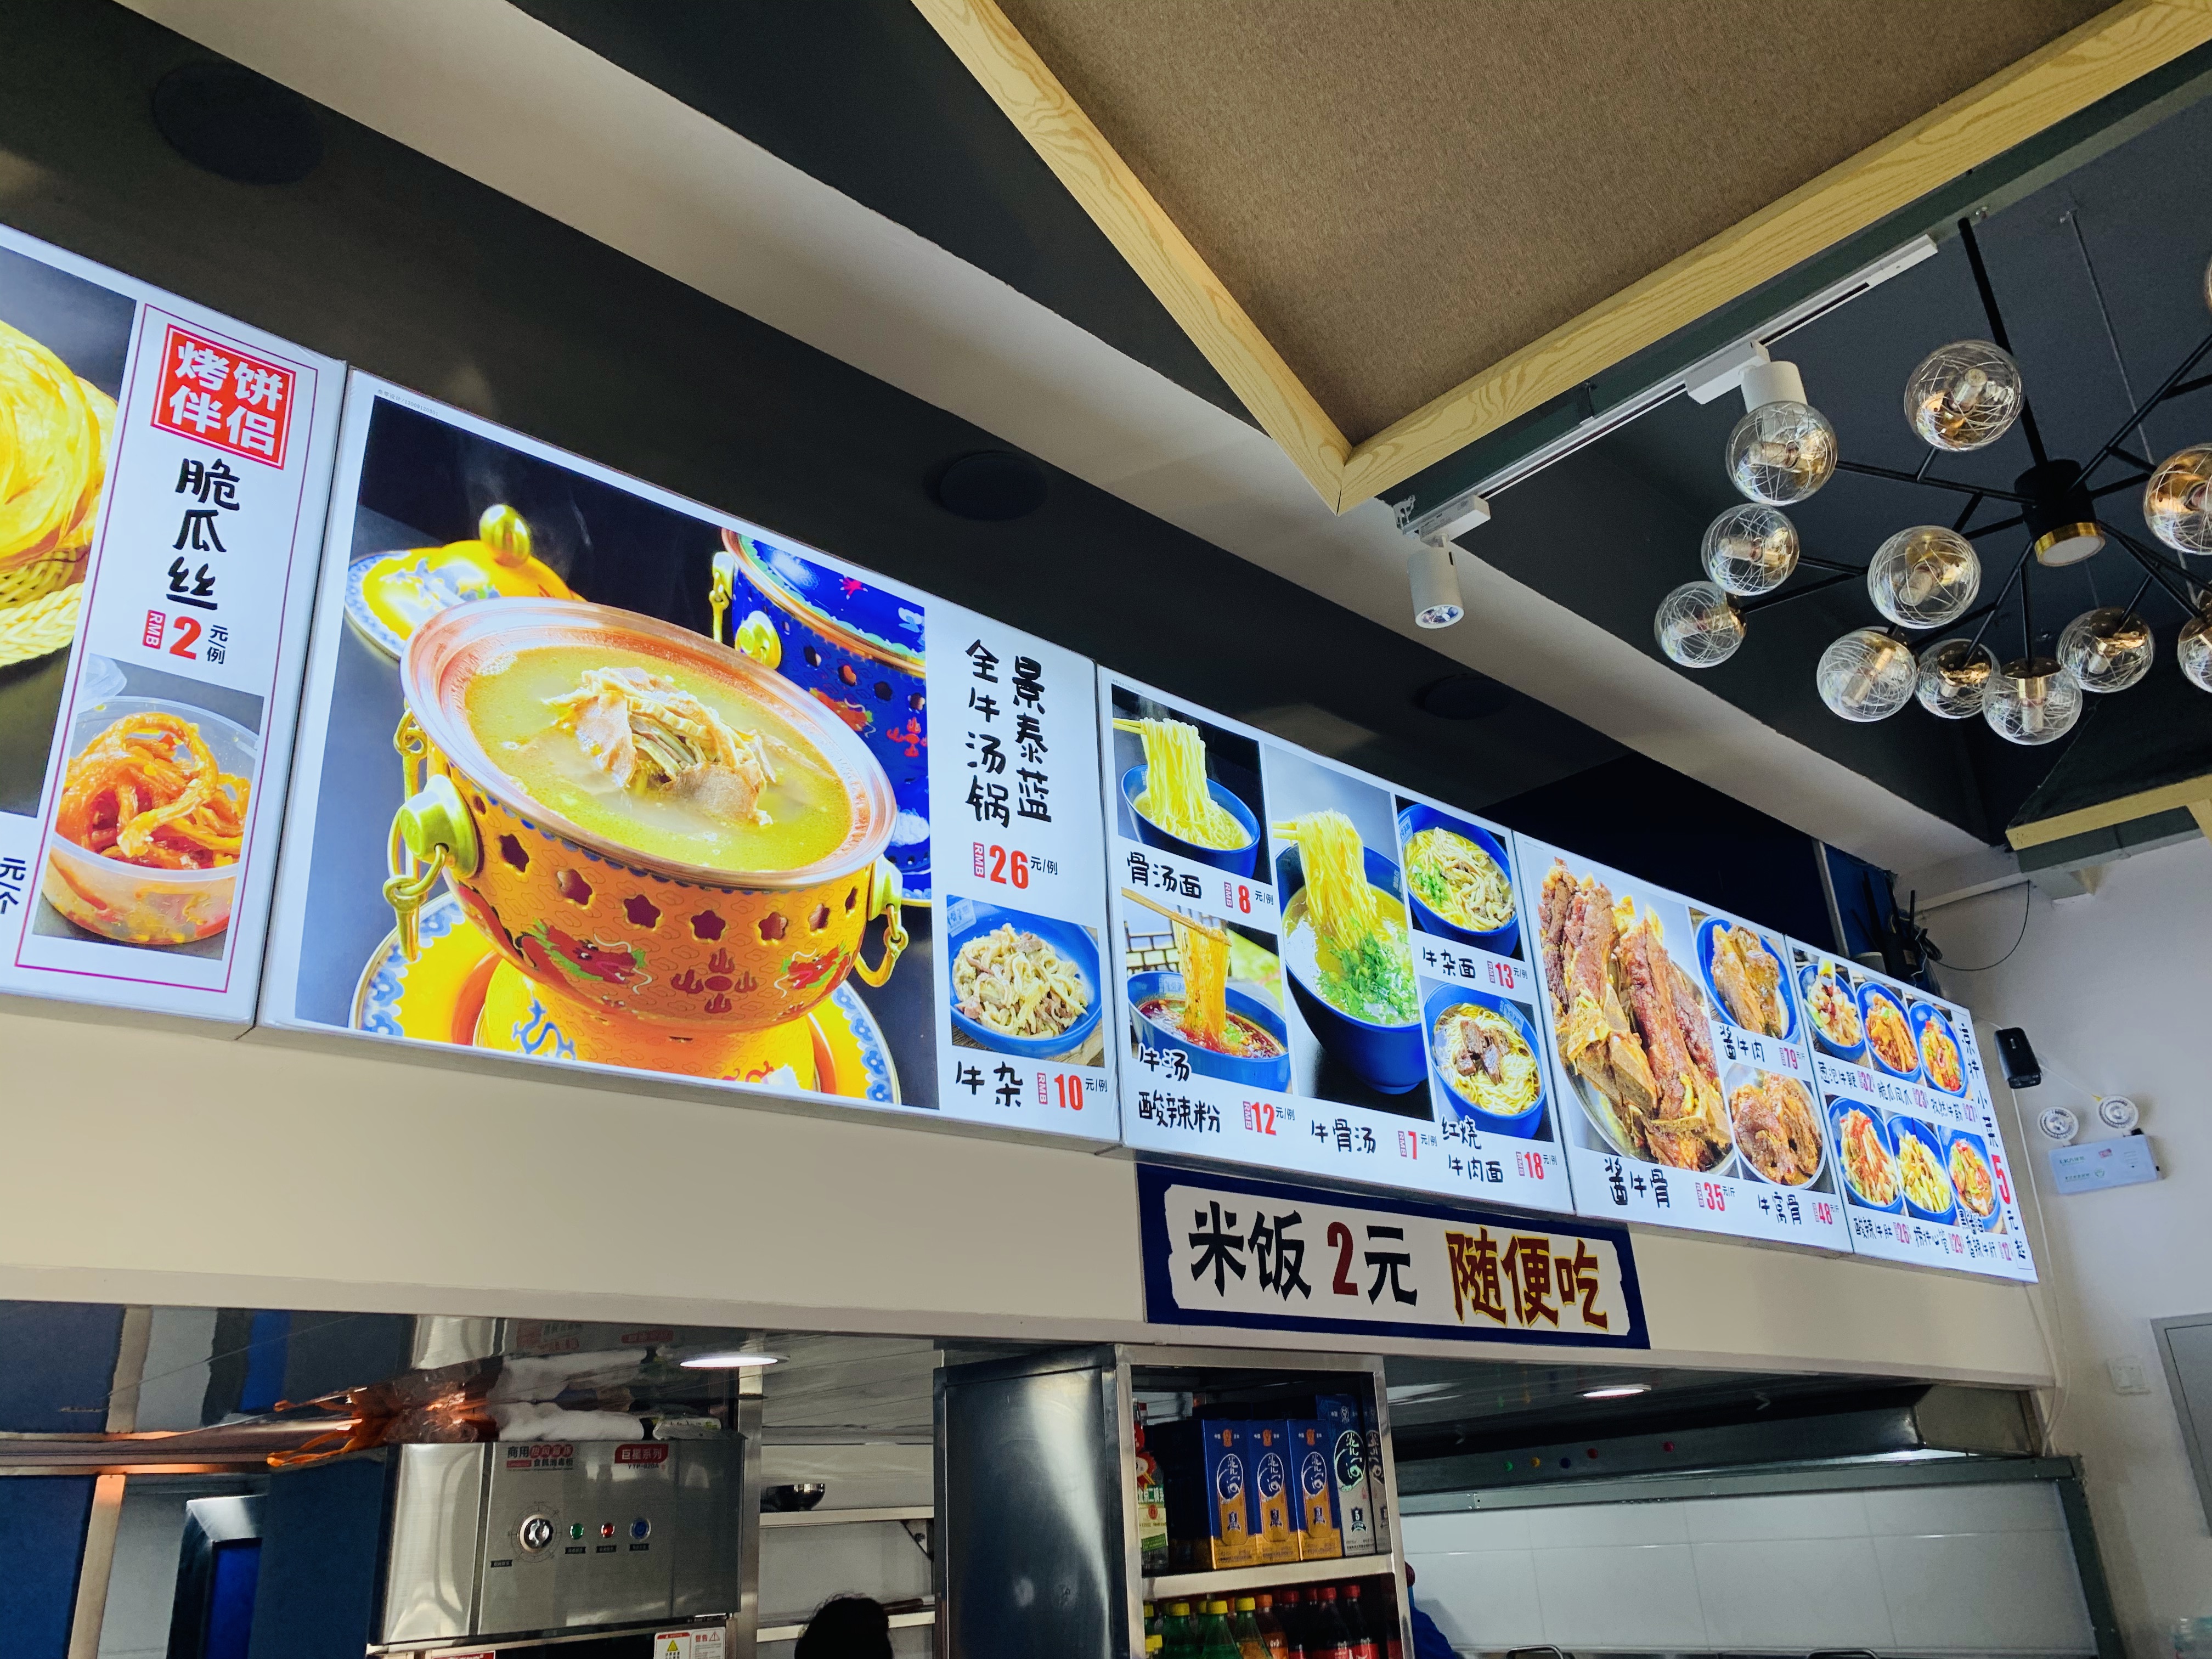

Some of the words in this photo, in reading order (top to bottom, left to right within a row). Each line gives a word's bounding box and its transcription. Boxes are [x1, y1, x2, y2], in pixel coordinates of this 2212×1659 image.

[176, 340, 283, 411] 烤饼
[170, 386, 276, 456] 伴侣
[166, 459, 240, 611] 脆瓜丝
[145, 612, 163, 646] RMB
[169, 616, 201, 660] 2
[206, 624, 228, 664] 元/例
[965, 639, 1010, 828] 全牛汤锅
[1013, 656, 1052, 823] 景泰蓝
[974, 844, 985, 877] RMB
[989, 845, 1029, 890] 26
[1030, 856, 1058, 876] 元/例
[1127, 851, 1201, 899] 骨汤面
[1224, 882, 1233, 909] RMB
[1238, 885, 1251, 914] 8
[1255, 890, 1274, 905] 元/例
[1423, 946, 1476, 979] 牛杂面
[1495, 962, 1514, 990] 13
[1719, 1025, 1765, 1062] 酱牛肉
[1139, 1046, 1190, 1082] 牛汤
[956, 1061, 1024, 1107] 牛杂
[1037, 1073, 1048, 1104] RMB
[1054, 1074, 1084, 1111] 10
[1085, 1079, 1108, 1092] 元/例
[1138, 1089, 1221, 1133] 酸辣粉
[1244, 1101, 1252, 1130] RMB
[1251, 1101, 1277, 1136] 12
[1276, 1107, 1295, 1121] 元/例
[1311, 1118, 1376, 1154] 牛骨汤
[1398, 1132, 1407, 1157] RMB
[1408, 1131, 1418, 1160] 7
[1442, 1116, 1482, 1150] 红烧
[1448, 1154, 1503, 1183] 牛肉面
[1516, 1153, 1525, 1176] RMB
[1524, 1152, 1544, 1180] 18
[1604, 1156, 1670, 1208] 酱牛骨
[1704, 1182, 1725, 1212] 35
[1818, 1202, 1833, 1225] 48
[1445, 1227, 1610, 1332] 随便吃
[622, 1448, 662, 1460] 巨星系列
[1355, 1510, 1360, 1520] 5
